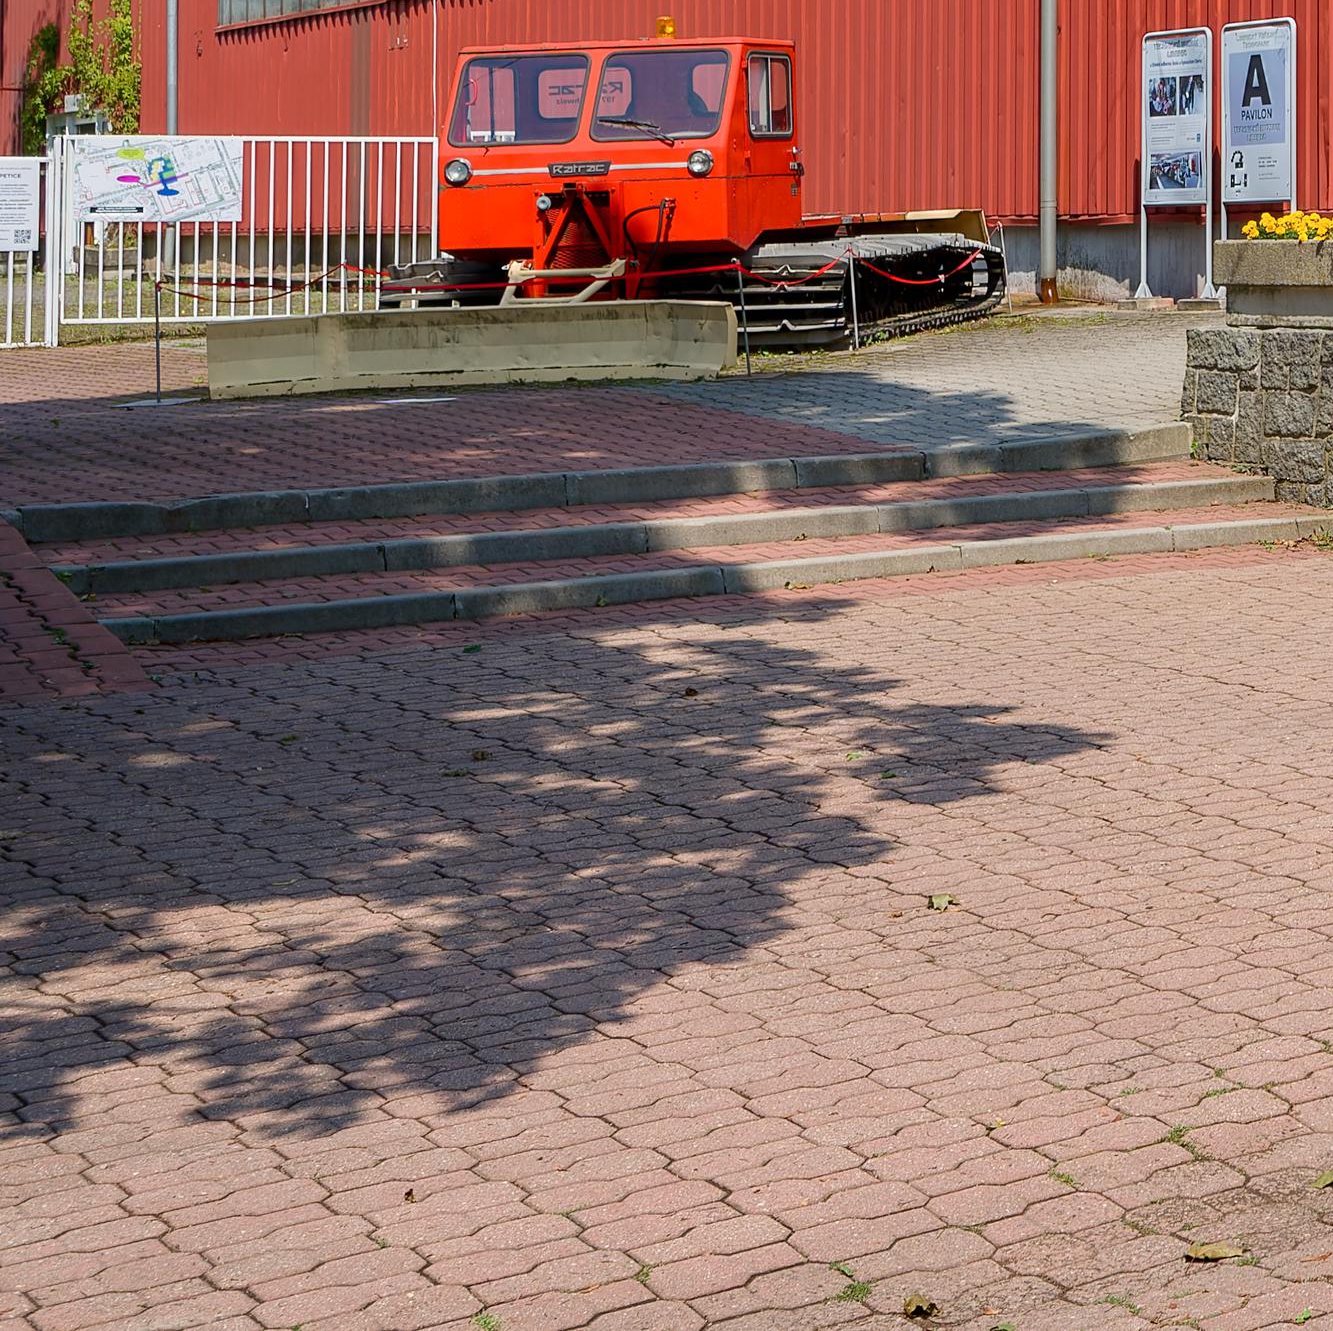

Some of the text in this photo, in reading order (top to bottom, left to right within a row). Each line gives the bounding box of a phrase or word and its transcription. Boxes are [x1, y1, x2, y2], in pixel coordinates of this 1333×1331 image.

[1241, 54, 1272, 107] A
[1241, 108, 1273, 121] PAVILON
[552, 164, 605, 174] Ratrac
